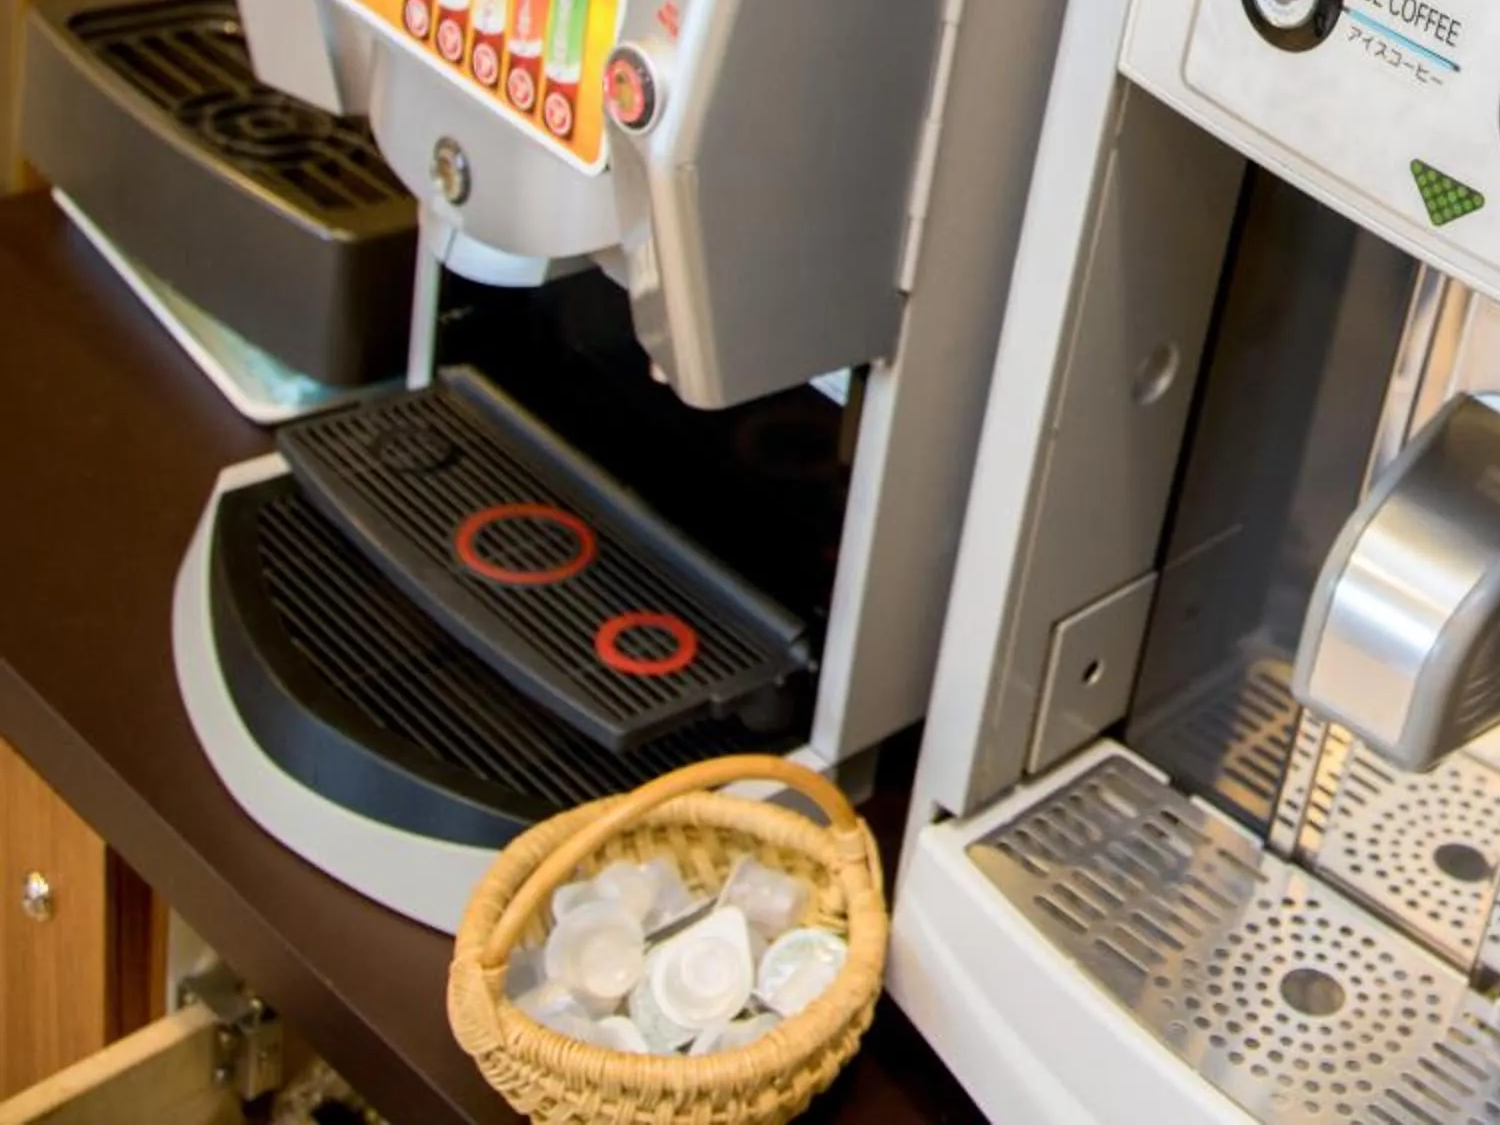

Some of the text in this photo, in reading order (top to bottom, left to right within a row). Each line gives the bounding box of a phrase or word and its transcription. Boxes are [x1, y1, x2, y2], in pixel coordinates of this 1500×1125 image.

[1348, 27, 1444, 87] アイスコーヒー
